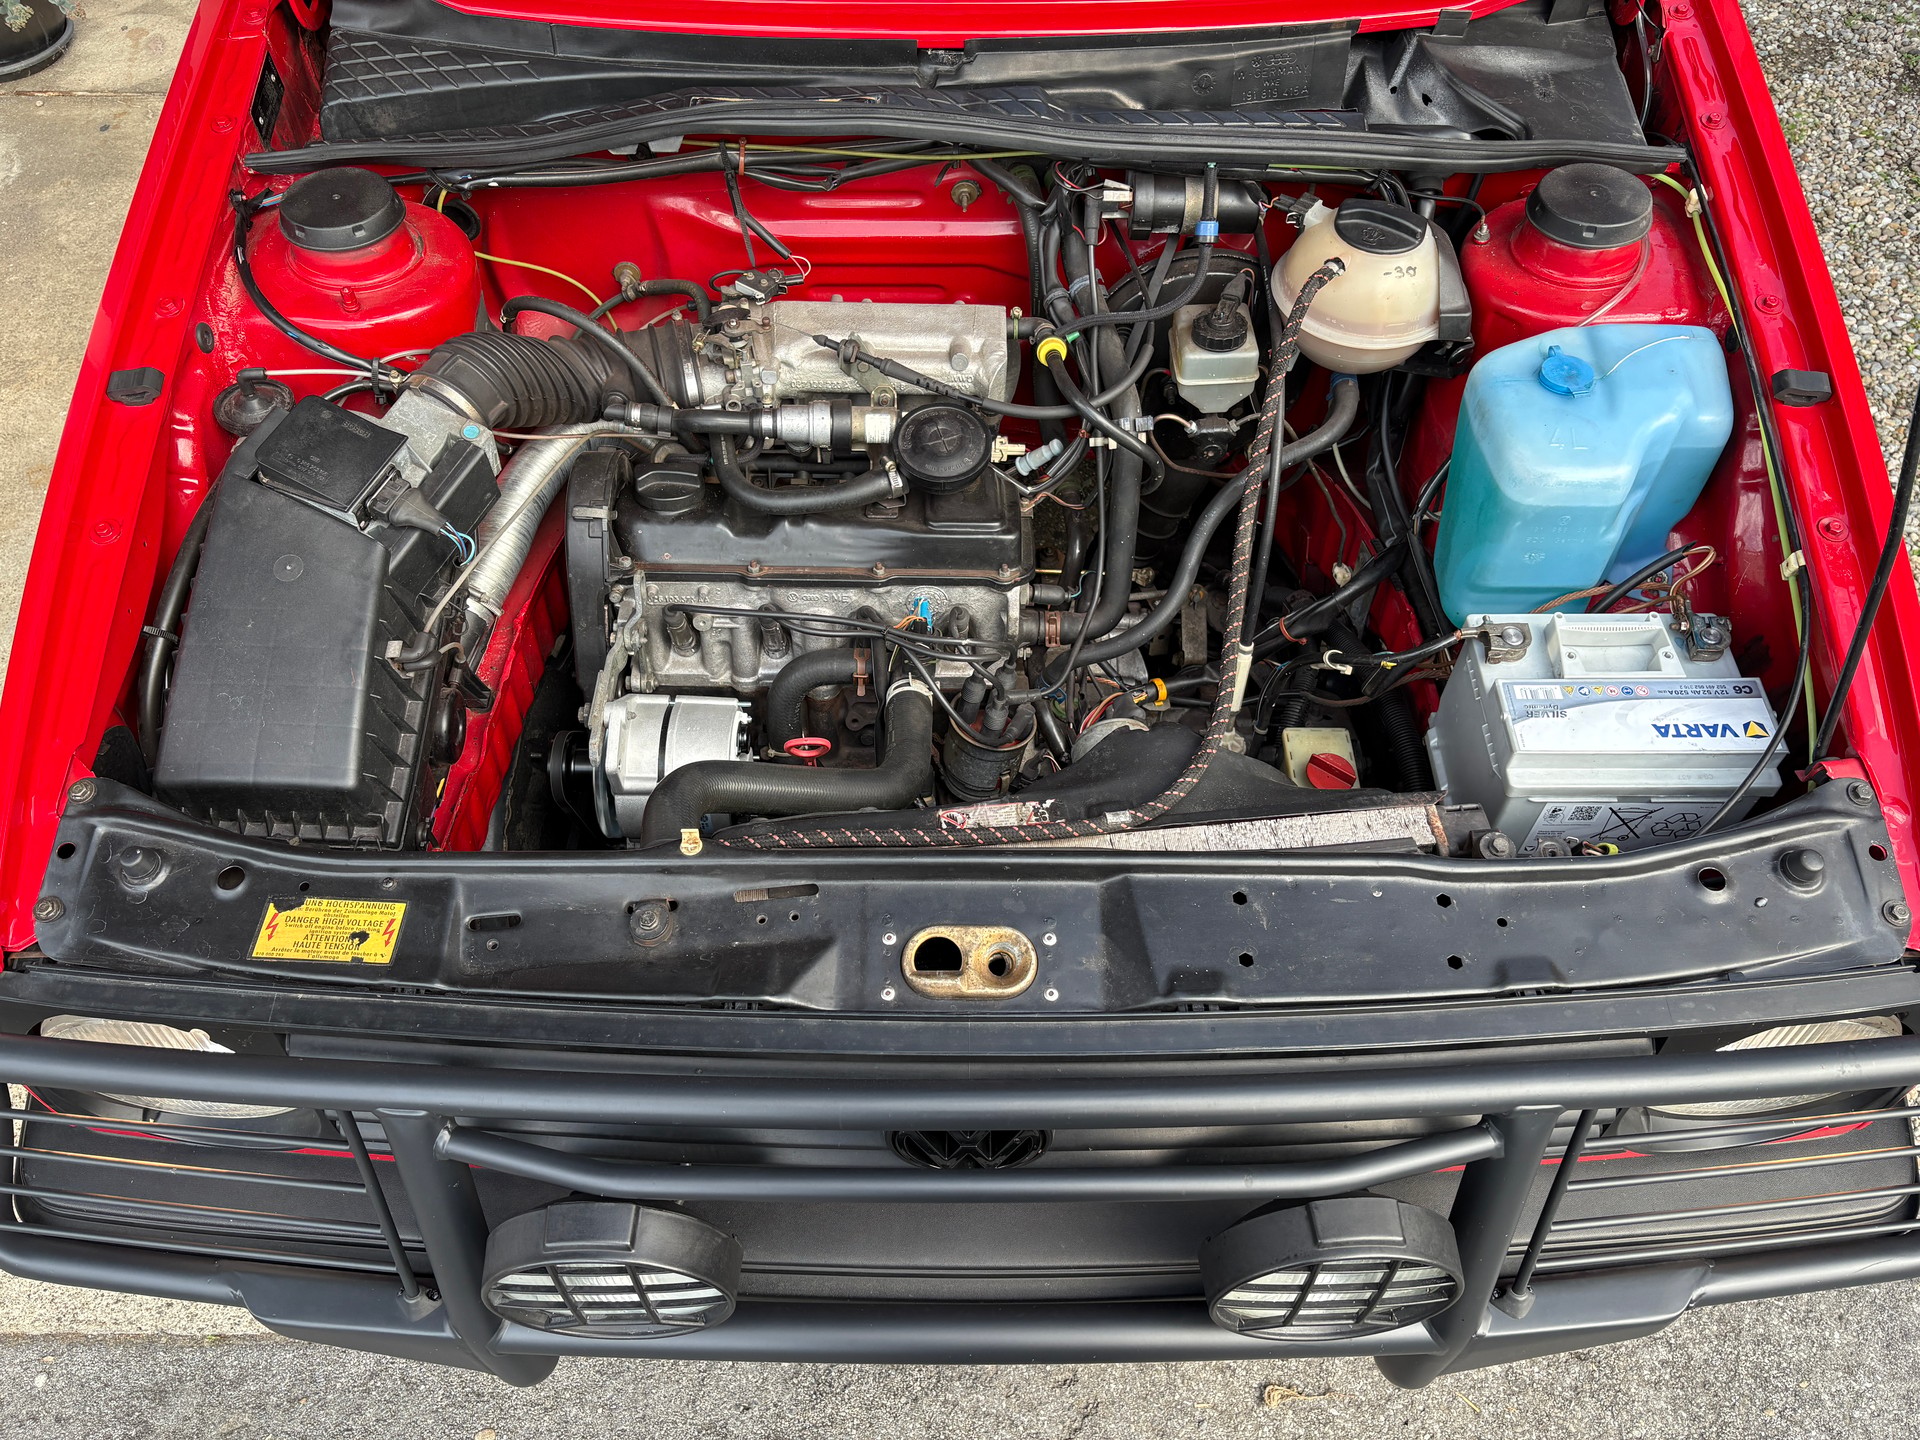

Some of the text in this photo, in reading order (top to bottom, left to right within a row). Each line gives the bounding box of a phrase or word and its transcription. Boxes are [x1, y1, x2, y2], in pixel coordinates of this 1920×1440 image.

[1732, 685, 1753, 695] C6
[1526, 710, 1568, 719] SILVER
[1651, 723, 1740, 738] VARTA
[326, 900, 396, 911] HOCHSPANNUNG
[344, 908, 377, 916] Zündanlage
[285, 915, 385, 928] DANGER HIGH VOLTAGE
[303, 933, 351, 943] ATTENTION
[293, 940, 360, 951] HAUTE TENSION
